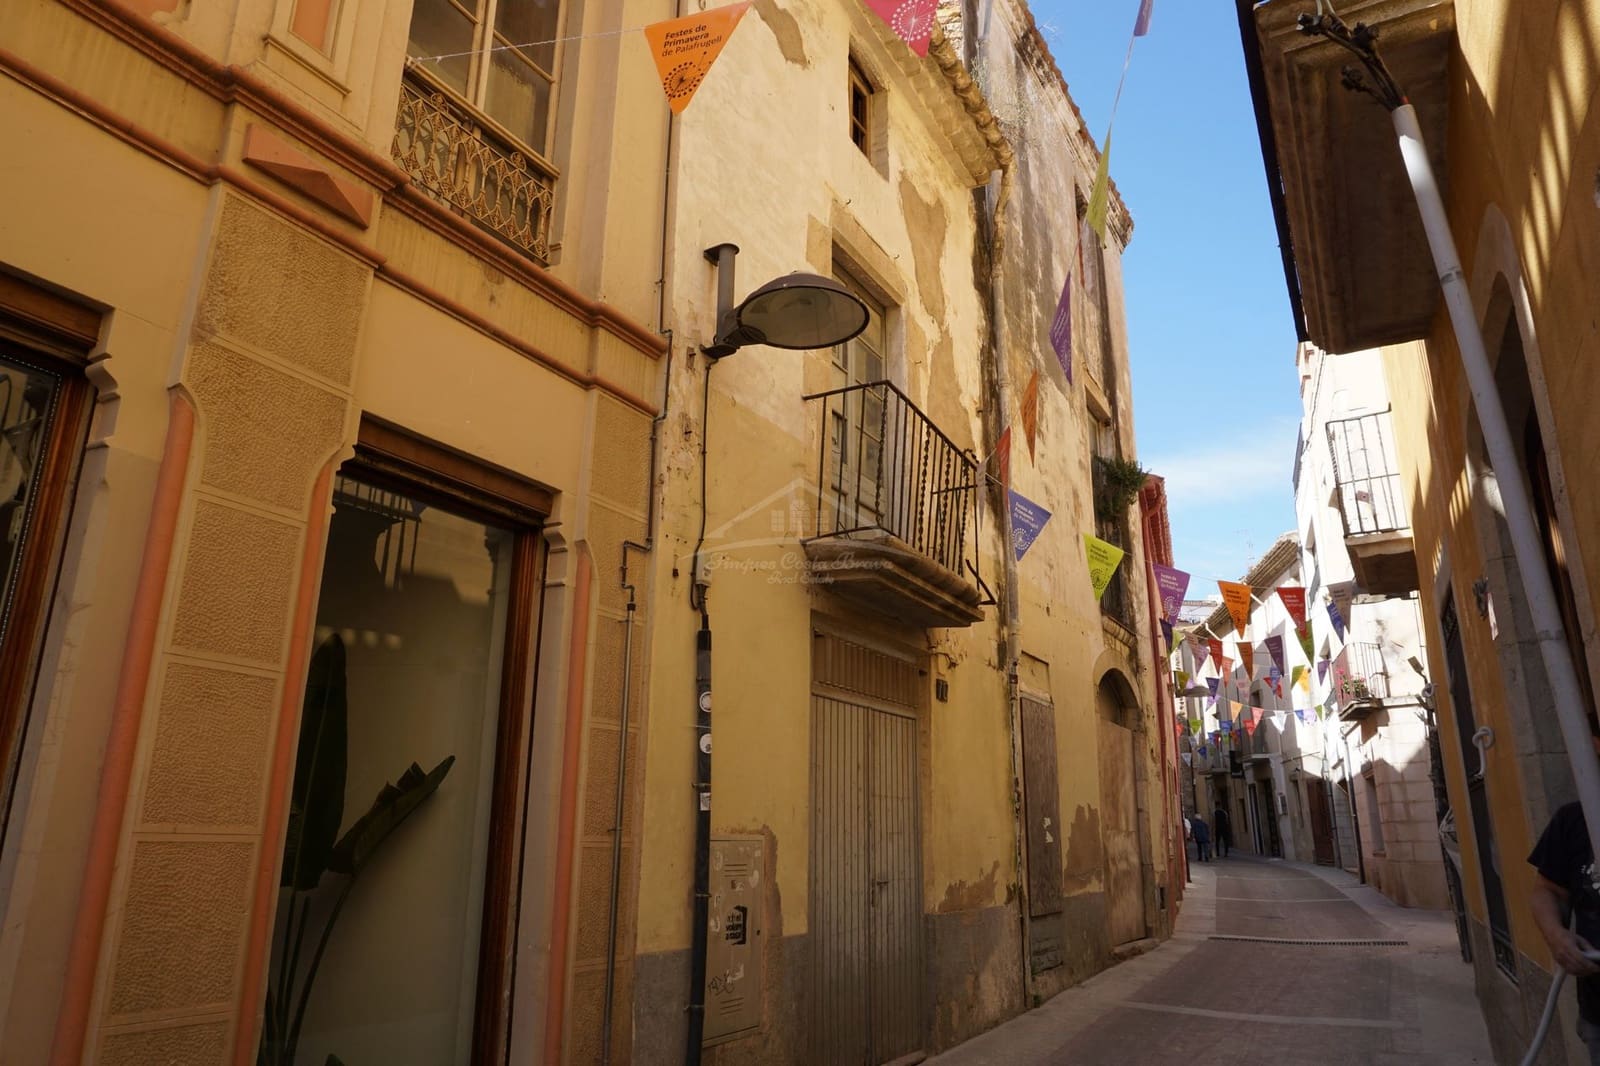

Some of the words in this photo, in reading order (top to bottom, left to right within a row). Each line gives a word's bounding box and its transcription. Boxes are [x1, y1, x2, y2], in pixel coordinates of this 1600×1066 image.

[664, 32, 709, 48] Primavera
[665, 27, 693, 40] Festes
[695, 24, 706, 33] de
[661, 49, 673, 57] de
[674, 35, 722, 54] Palafrugell
